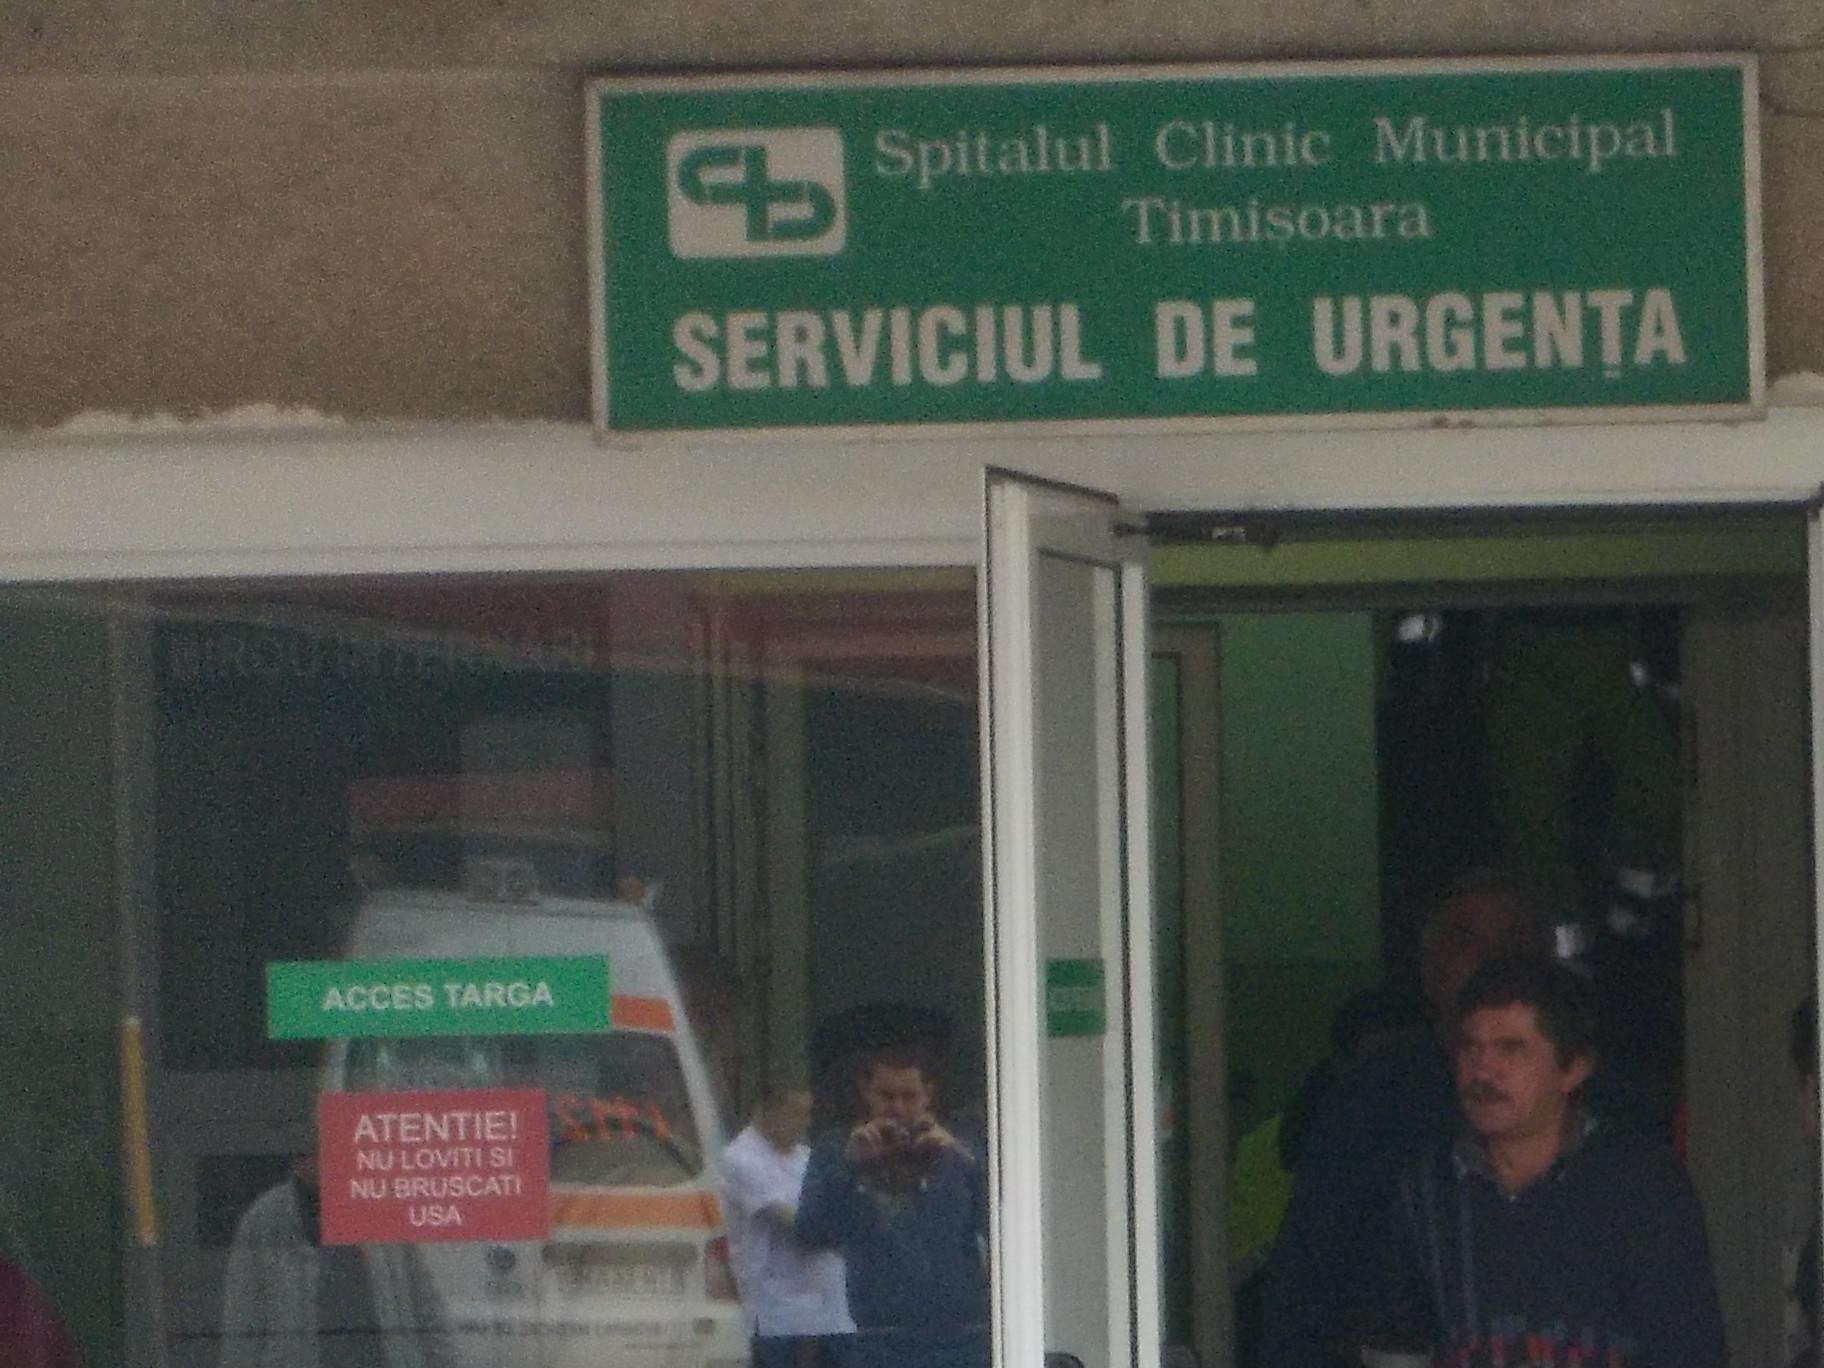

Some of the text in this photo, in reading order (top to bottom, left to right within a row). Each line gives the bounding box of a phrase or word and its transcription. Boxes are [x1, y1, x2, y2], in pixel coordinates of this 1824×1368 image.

[875, 107, 1677, 190] Spitalul Clinic Municipal
[671, 303, 1101, 393] SERVICIUL
[1154, 298, 1258, 379] DE
[321, 981, 554, 1012] ACCES TARGA
[353, 1110, 519, 1144] ATENTIE!
[355, 1146, 514, 1172] NU LOVITI SI
[350, 1175, 522, 1200] NU BRUSCATI
[408, 1205, 463, 1228] USA
